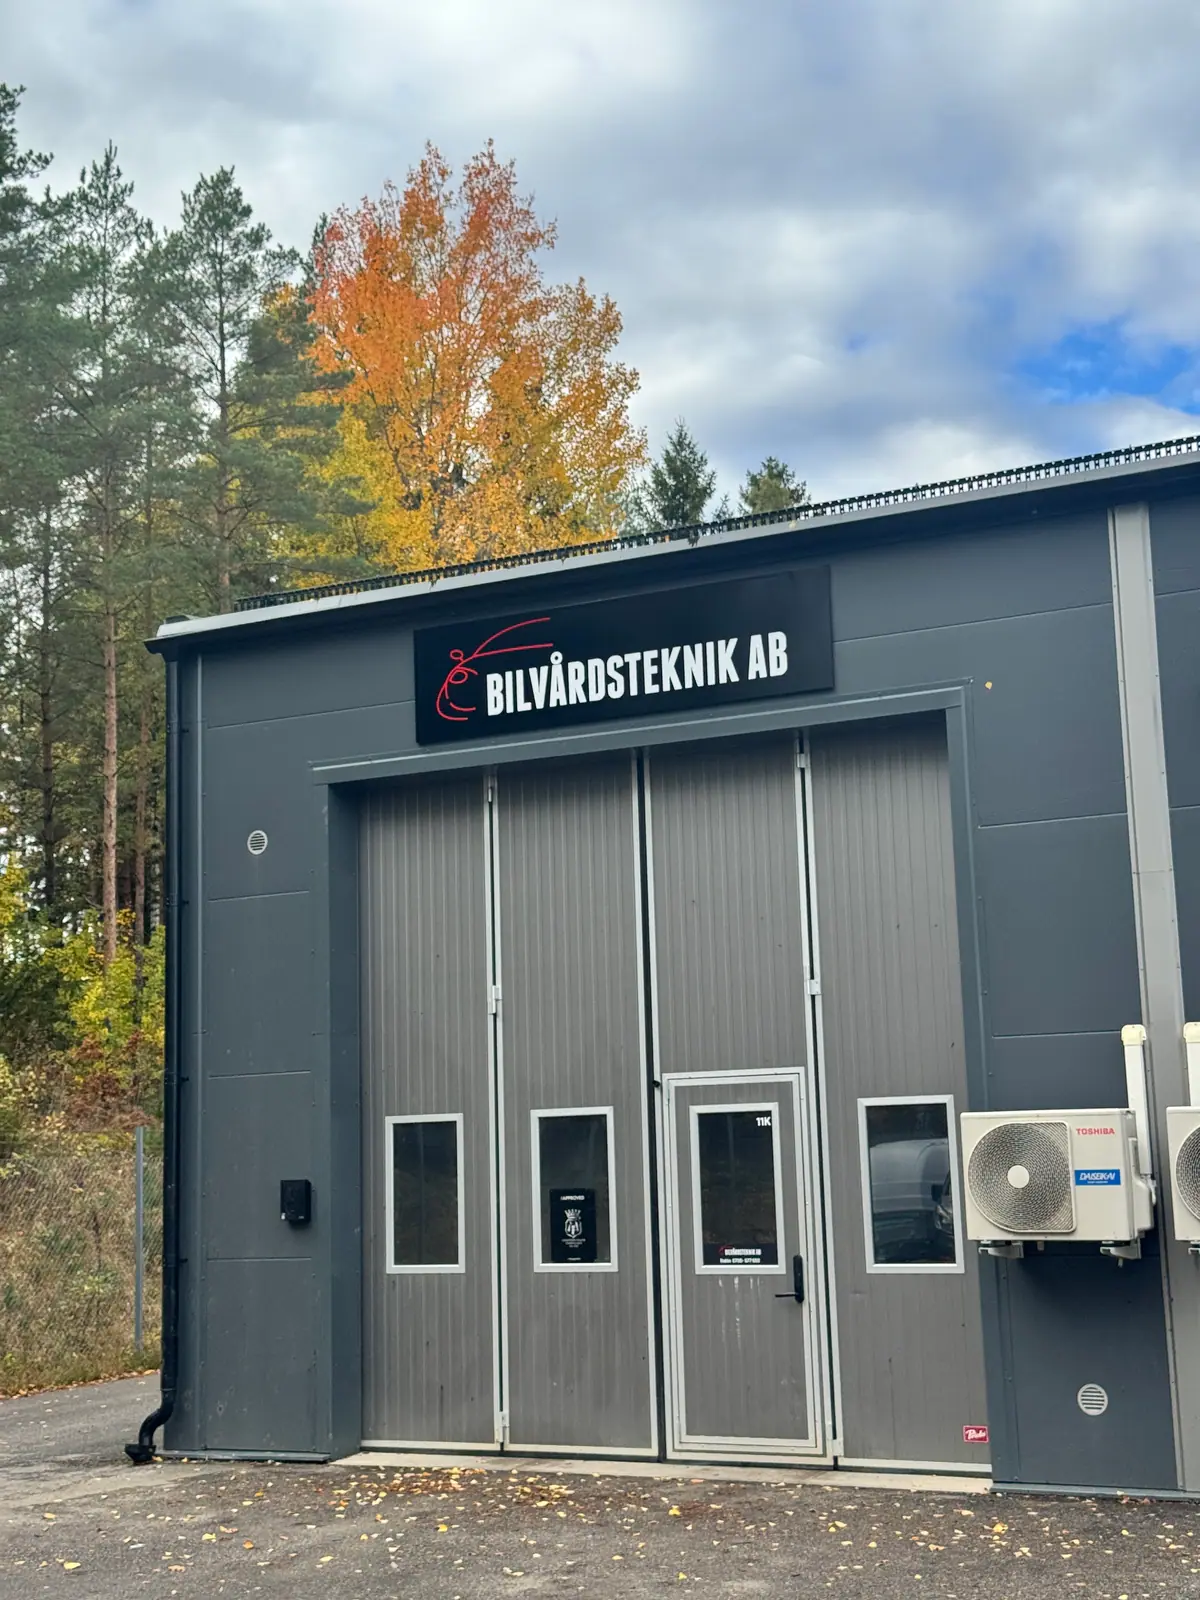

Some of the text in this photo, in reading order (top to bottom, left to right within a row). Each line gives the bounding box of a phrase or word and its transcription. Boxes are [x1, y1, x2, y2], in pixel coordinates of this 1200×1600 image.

[486, 630, 788, 716] BILVÅRDSTEKNIK AB
[755, 1116, 772, 1127] 11K
[1075, 1127, 1115, 1136] TOSHIBA
